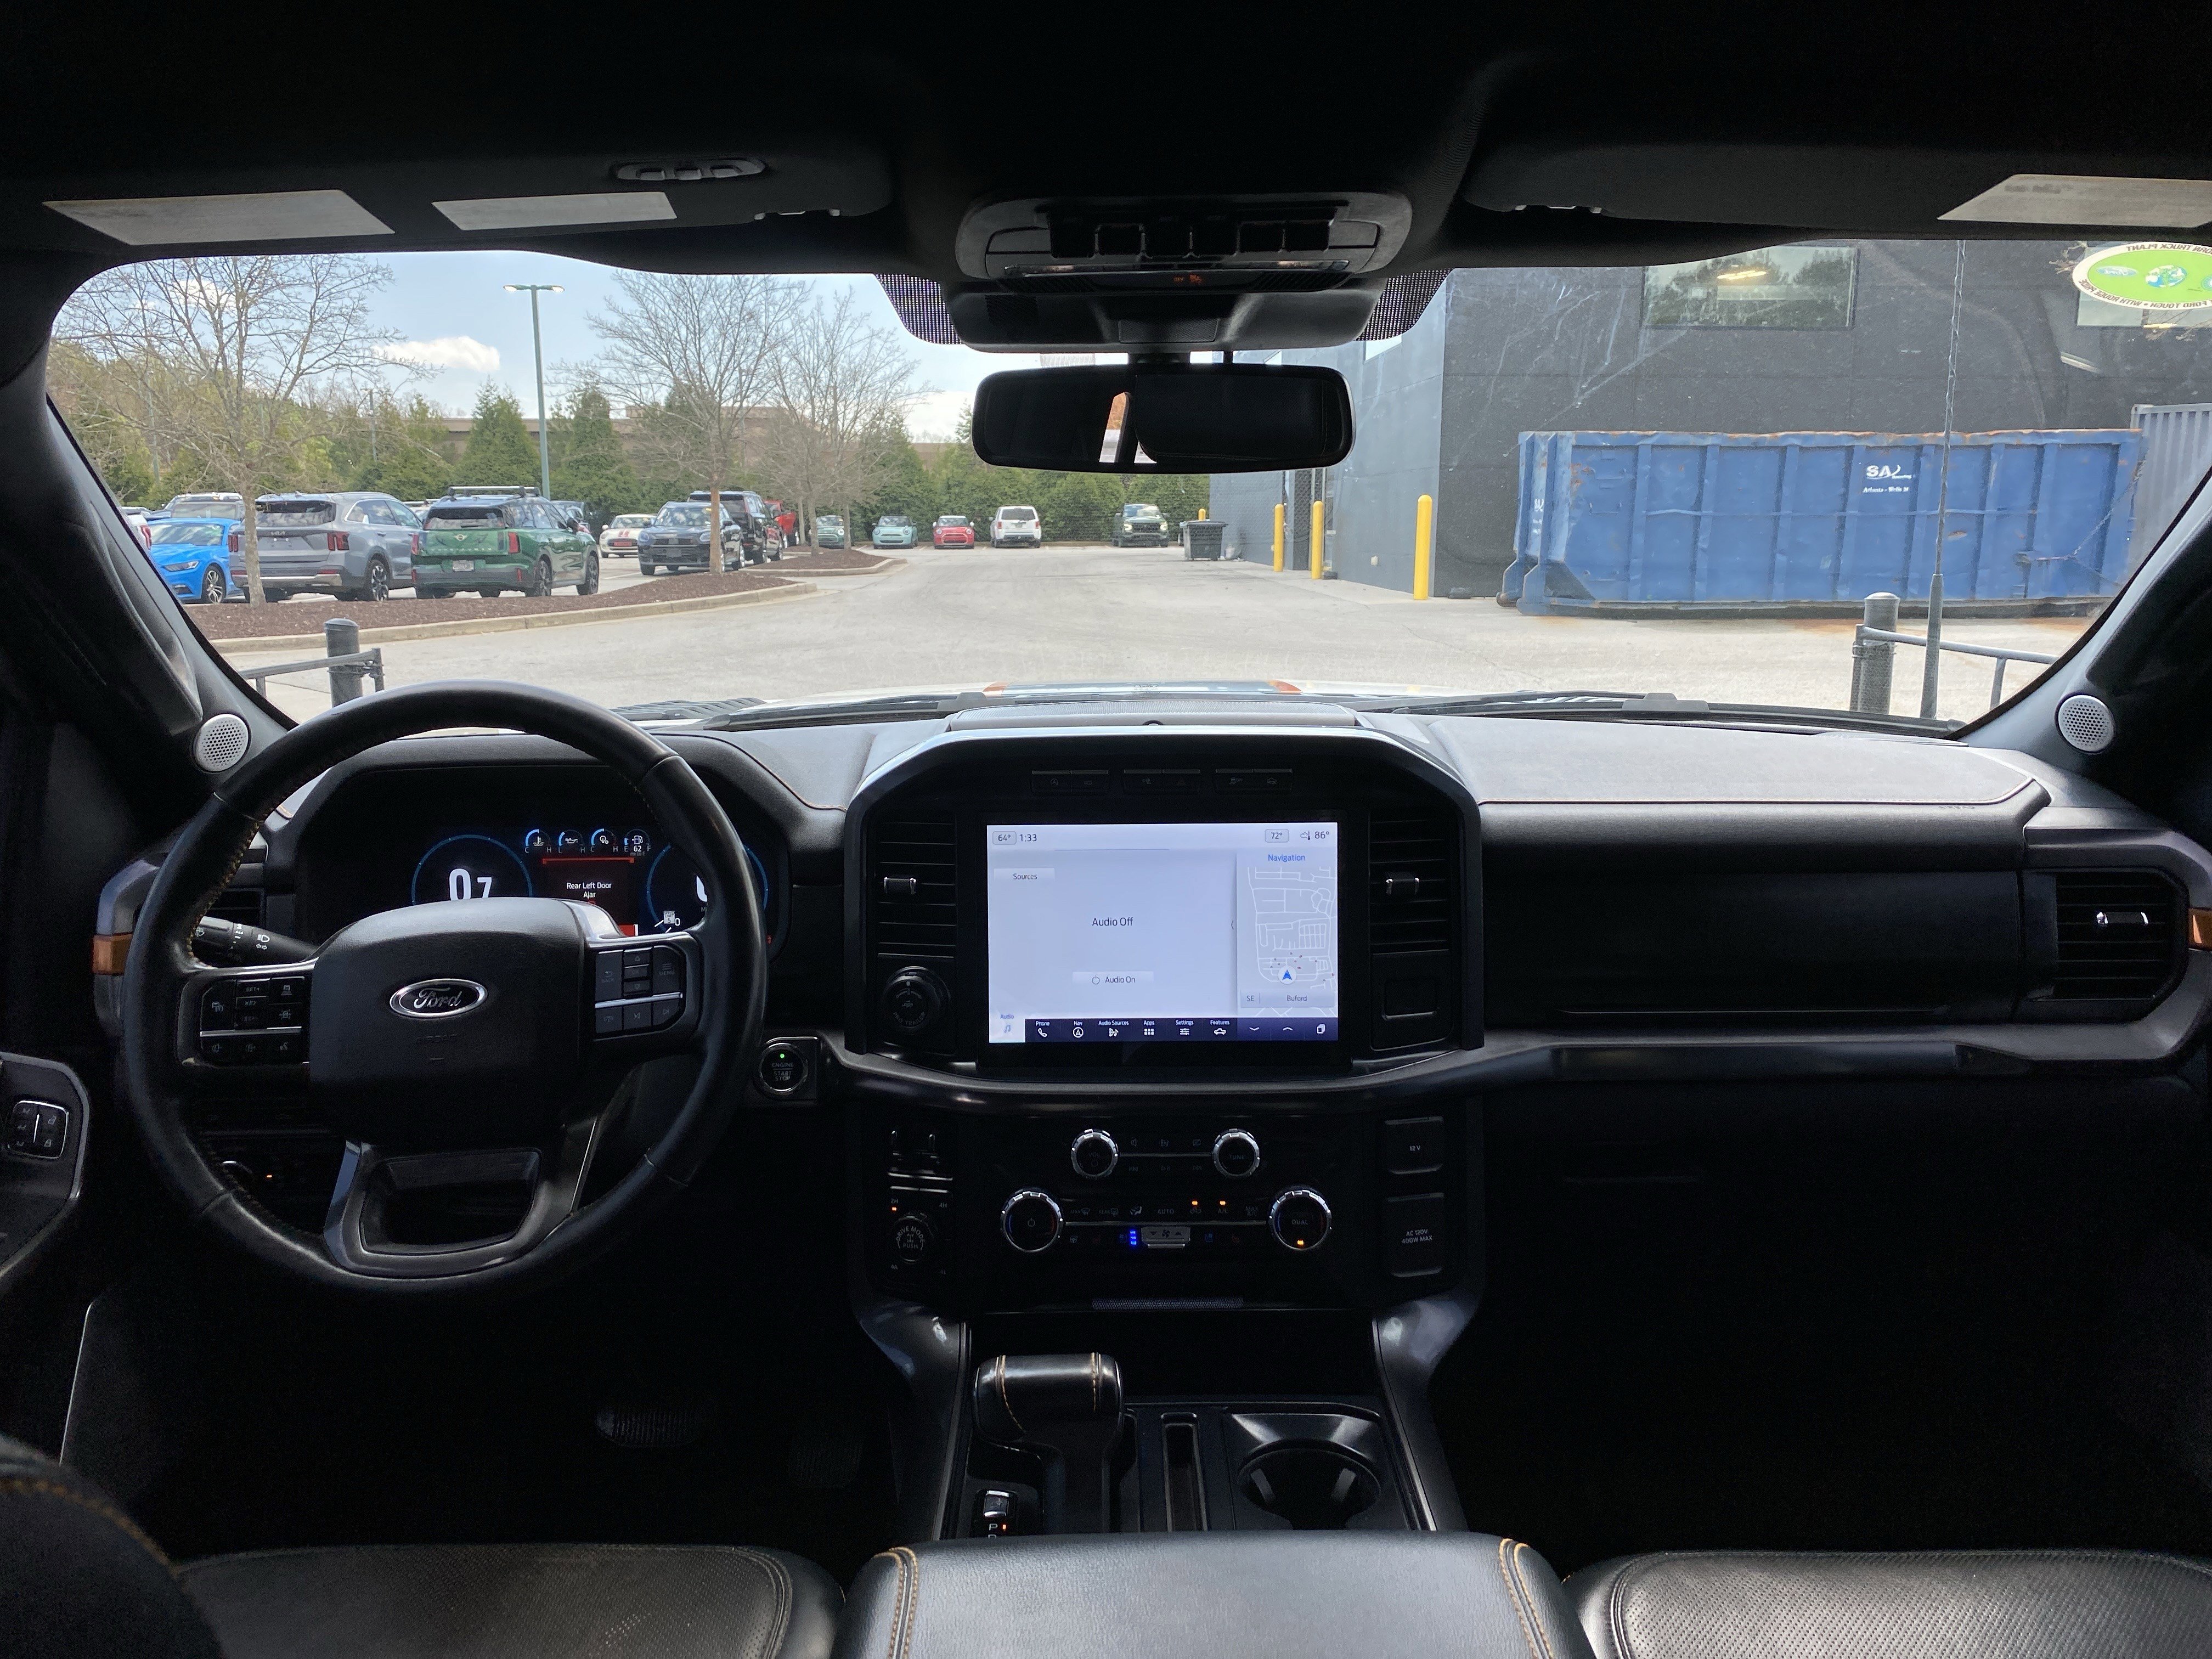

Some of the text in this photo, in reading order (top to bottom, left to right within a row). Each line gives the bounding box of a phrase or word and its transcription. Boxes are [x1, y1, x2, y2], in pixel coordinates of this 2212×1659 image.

[1019, 834, 1037, 842] 1:33
[1314, 831, 1329, 839] 86°
[1268, 854, 1306, 862] Navigation
[582, 881, 596, 889] Left
[583, 891, 596, 900] Ajar
[1092, 917, 1133, 927] Audio Off
[1104, 975, 1136, 984] Audio On
[413, 987, 462, 1009] Ford
[1286, 994, 1307, 1003] Buford
[895, 1225, 926, 1243] DRIVE MODE
